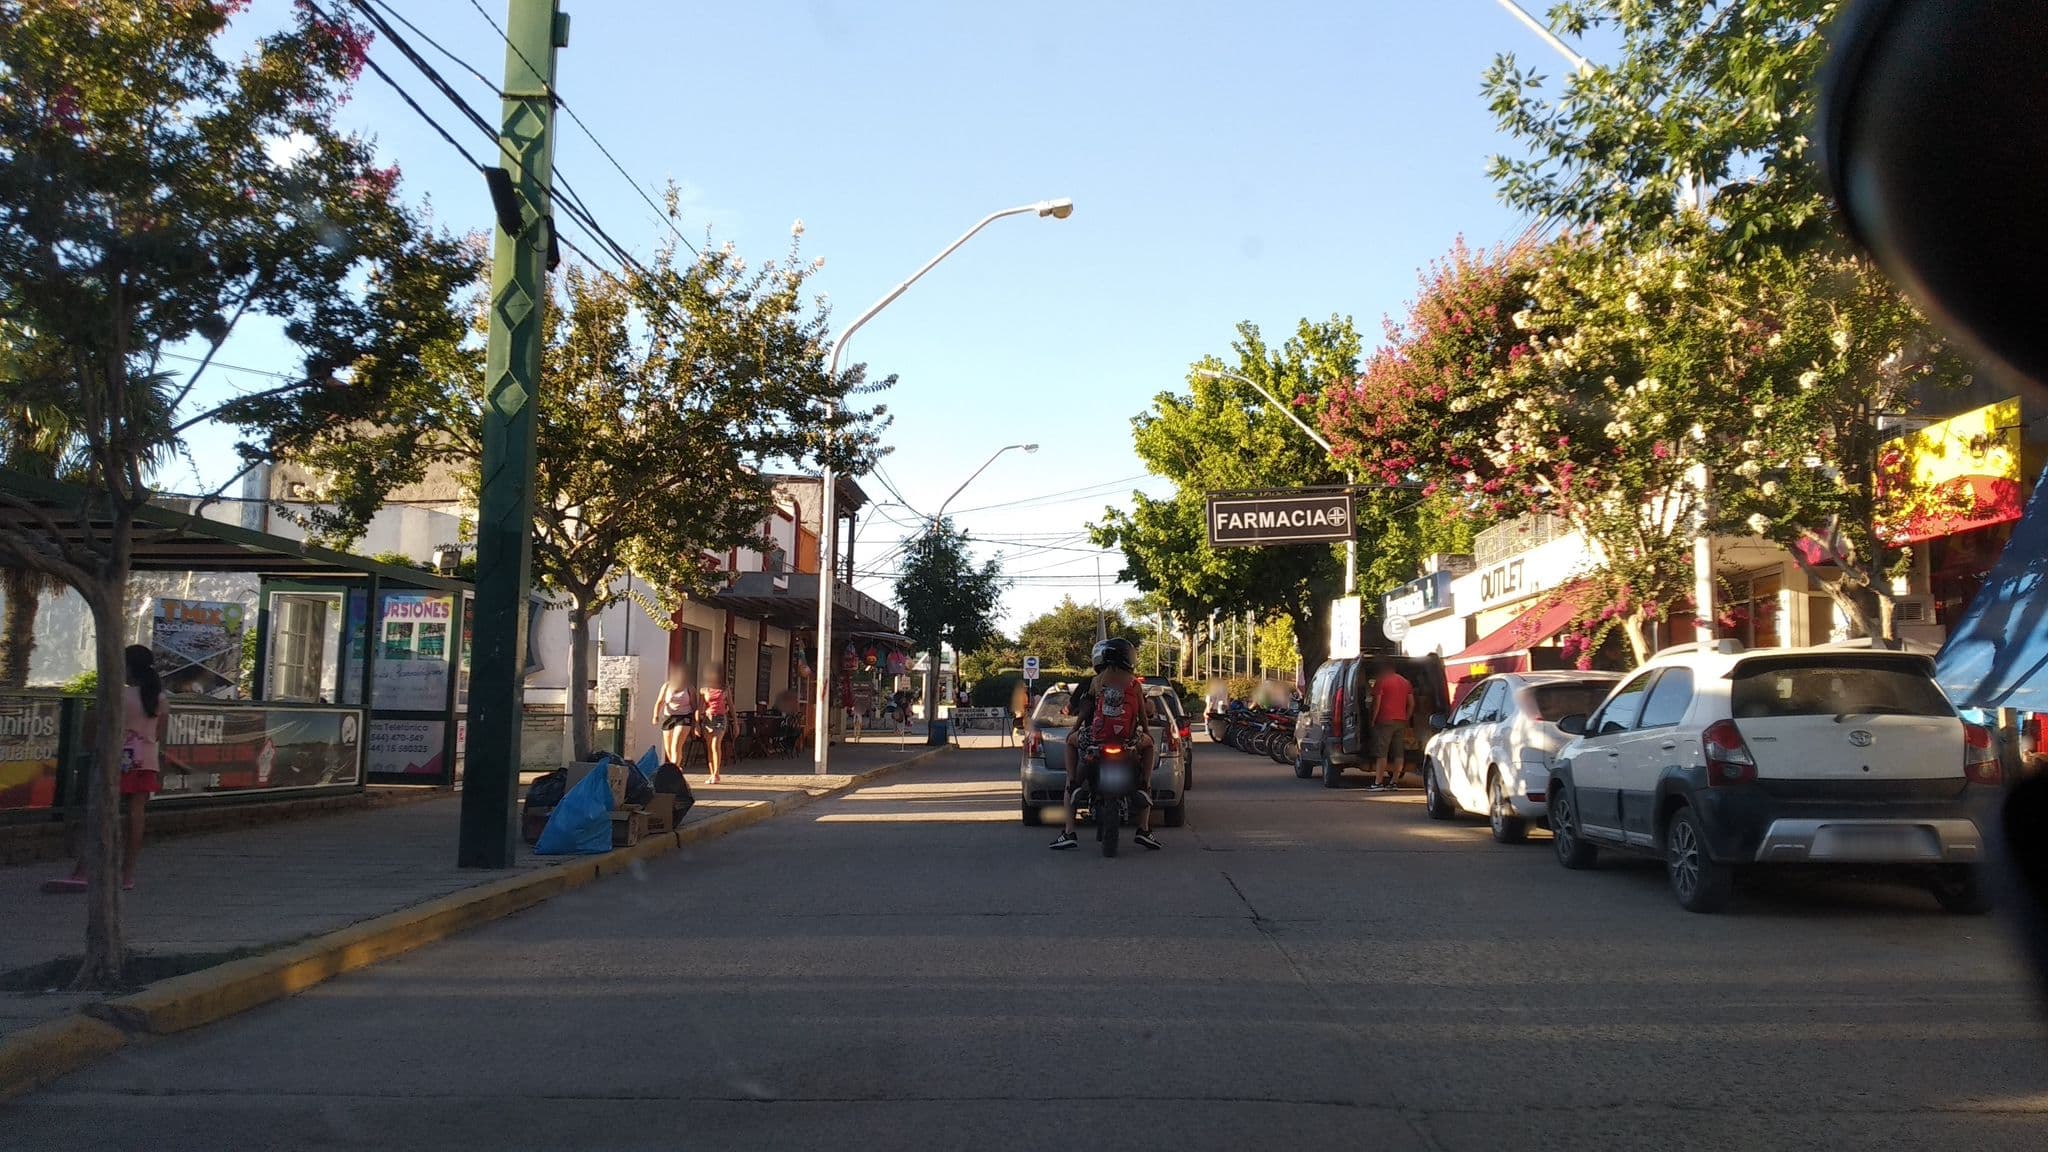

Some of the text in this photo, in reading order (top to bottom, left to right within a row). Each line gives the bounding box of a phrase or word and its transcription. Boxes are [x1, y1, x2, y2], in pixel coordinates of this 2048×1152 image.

[1218, 509, 1327, 530] FARMACIA
[1481, 558, 1524, 602] OUTLET
[167, 714, 224, 744] NAVEGA
